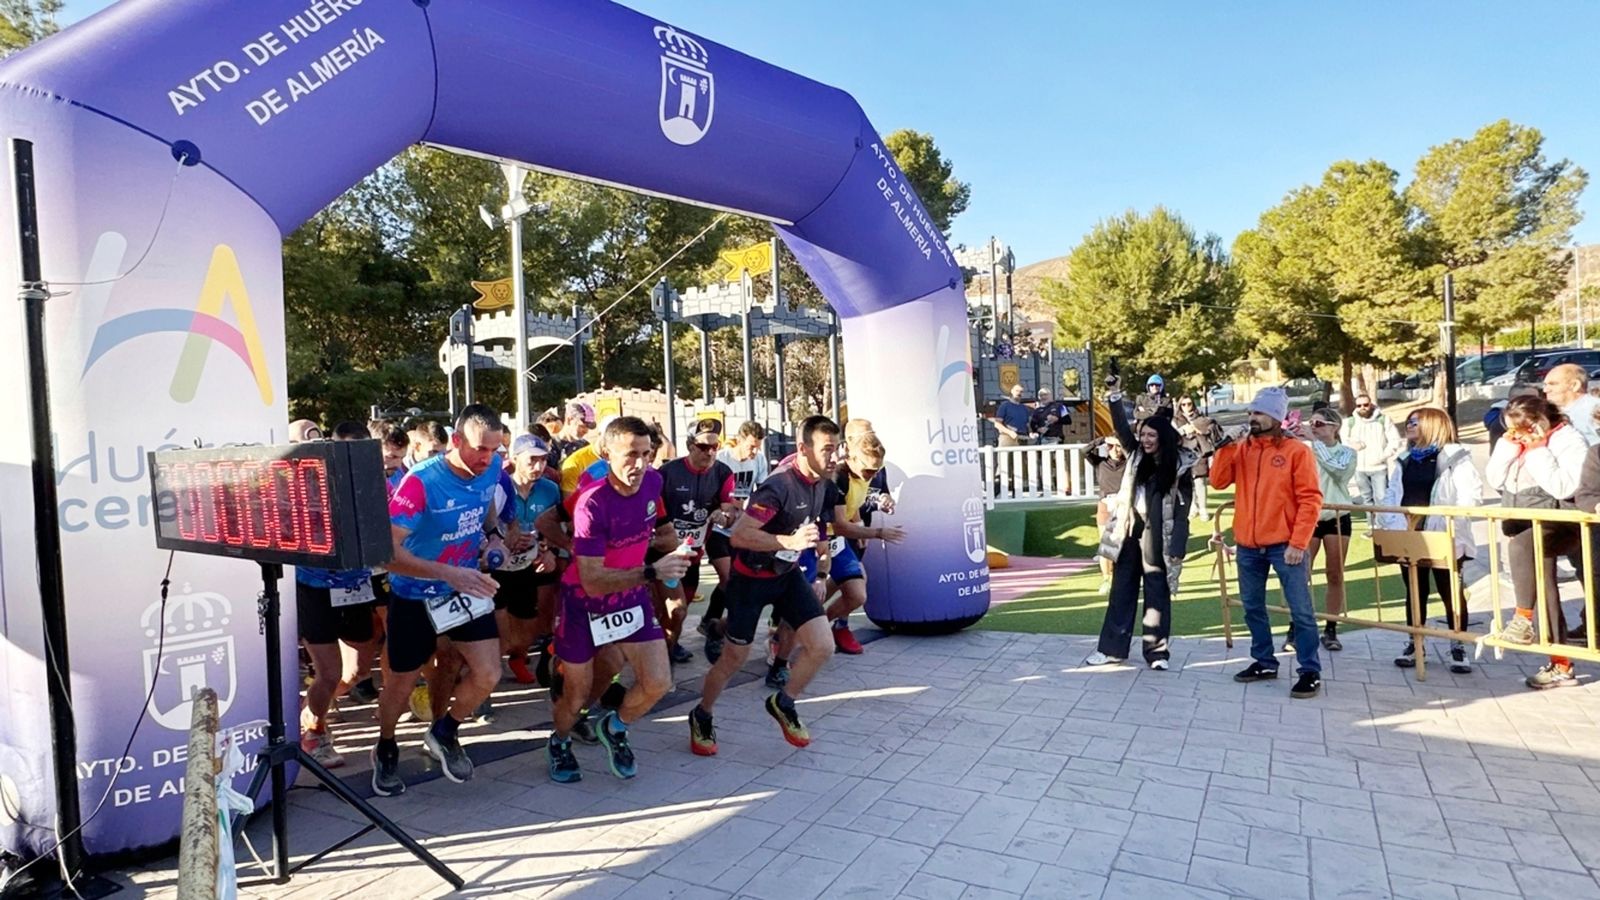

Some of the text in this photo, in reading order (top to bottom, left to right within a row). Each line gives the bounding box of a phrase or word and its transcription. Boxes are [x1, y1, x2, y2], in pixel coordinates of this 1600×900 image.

[168, 61, 250, 116] AYTO.
[242, 32, 288, 66] DE
[245, 27, 385, 126] DE ALMERÍA
[870, 143, 898, 184] AYTO.
[899, 183, 912, 205] DE
[876, 177, 894, 201] DE
[958, 586, 972, 597] DE
[601, 611, 634, 630] 100
[152, 744, 189, 768] DE
[114, 784, 152, 807] DE
